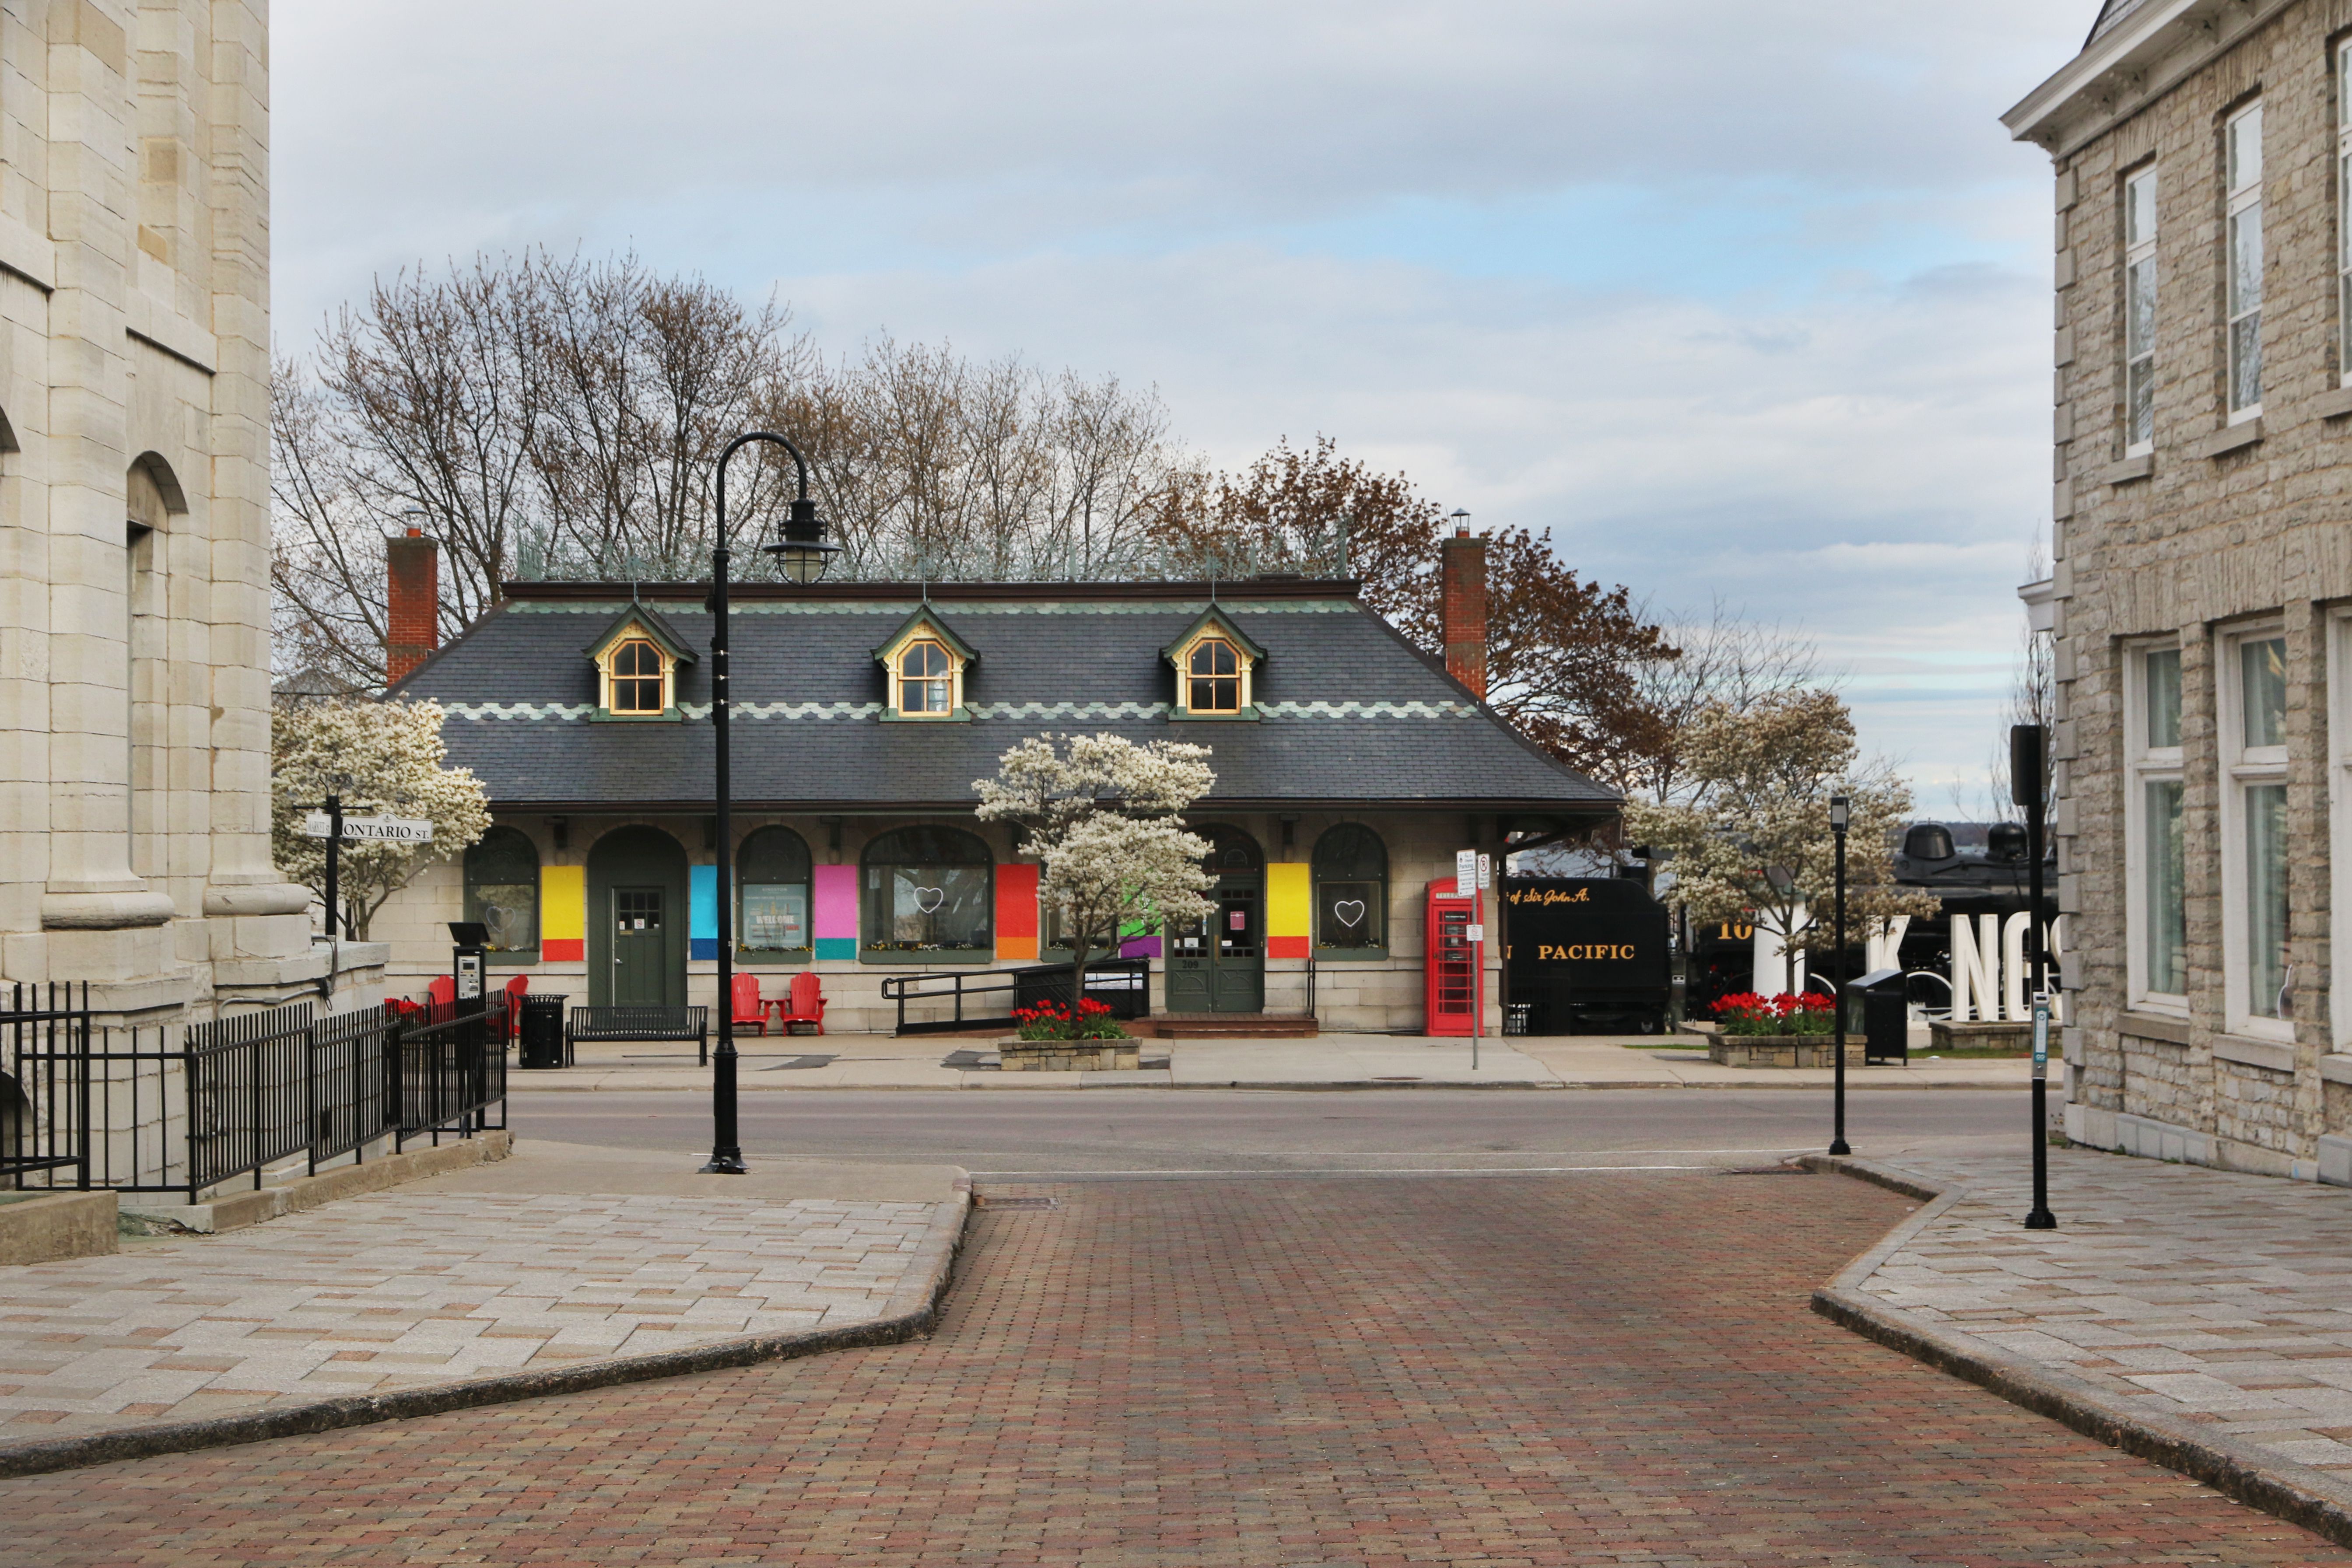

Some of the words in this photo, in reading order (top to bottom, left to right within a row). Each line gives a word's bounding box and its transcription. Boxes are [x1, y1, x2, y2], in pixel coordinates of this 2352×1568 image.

[344, 824, 410, 838] ONTARIO
[415, 830, 429, 839] ST.
[1510, 889, 1521, 905] of
[1523, 888, 1542, 903] Sir
[1543, 889, 1571, 906] John
[1571, 888, 1590, 903] A.
[756, 915, 795, 924] WELCOME
[1538, 945, 1635, 959] PACIFIC
[1182, 959, 1199, 969] 209
